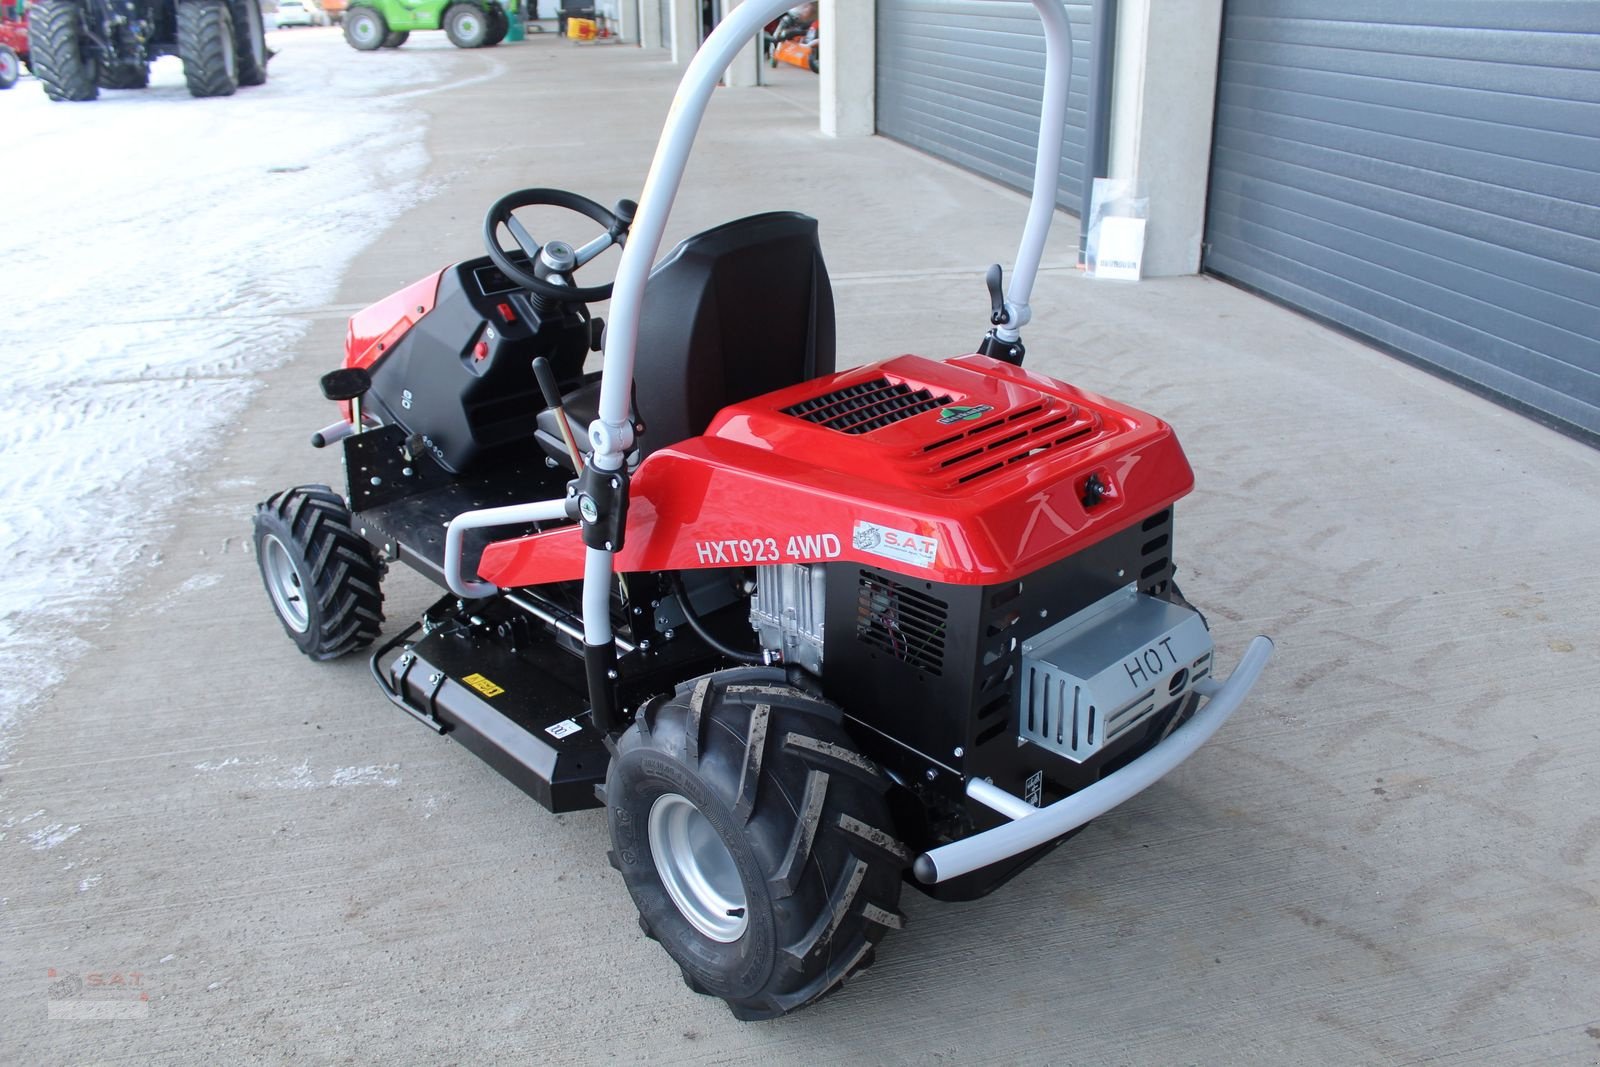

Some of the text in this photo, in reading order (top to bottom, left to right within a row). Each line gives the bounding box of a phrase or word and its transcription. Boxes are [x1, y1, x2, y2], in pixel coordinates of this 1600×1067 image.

[696, 538, 780, 564] HXT923
[786, 533, 841, 559] 4WD
[884, 531, 934, 555] S.A.T.
[1124, 636, 1177, 688] HOT
